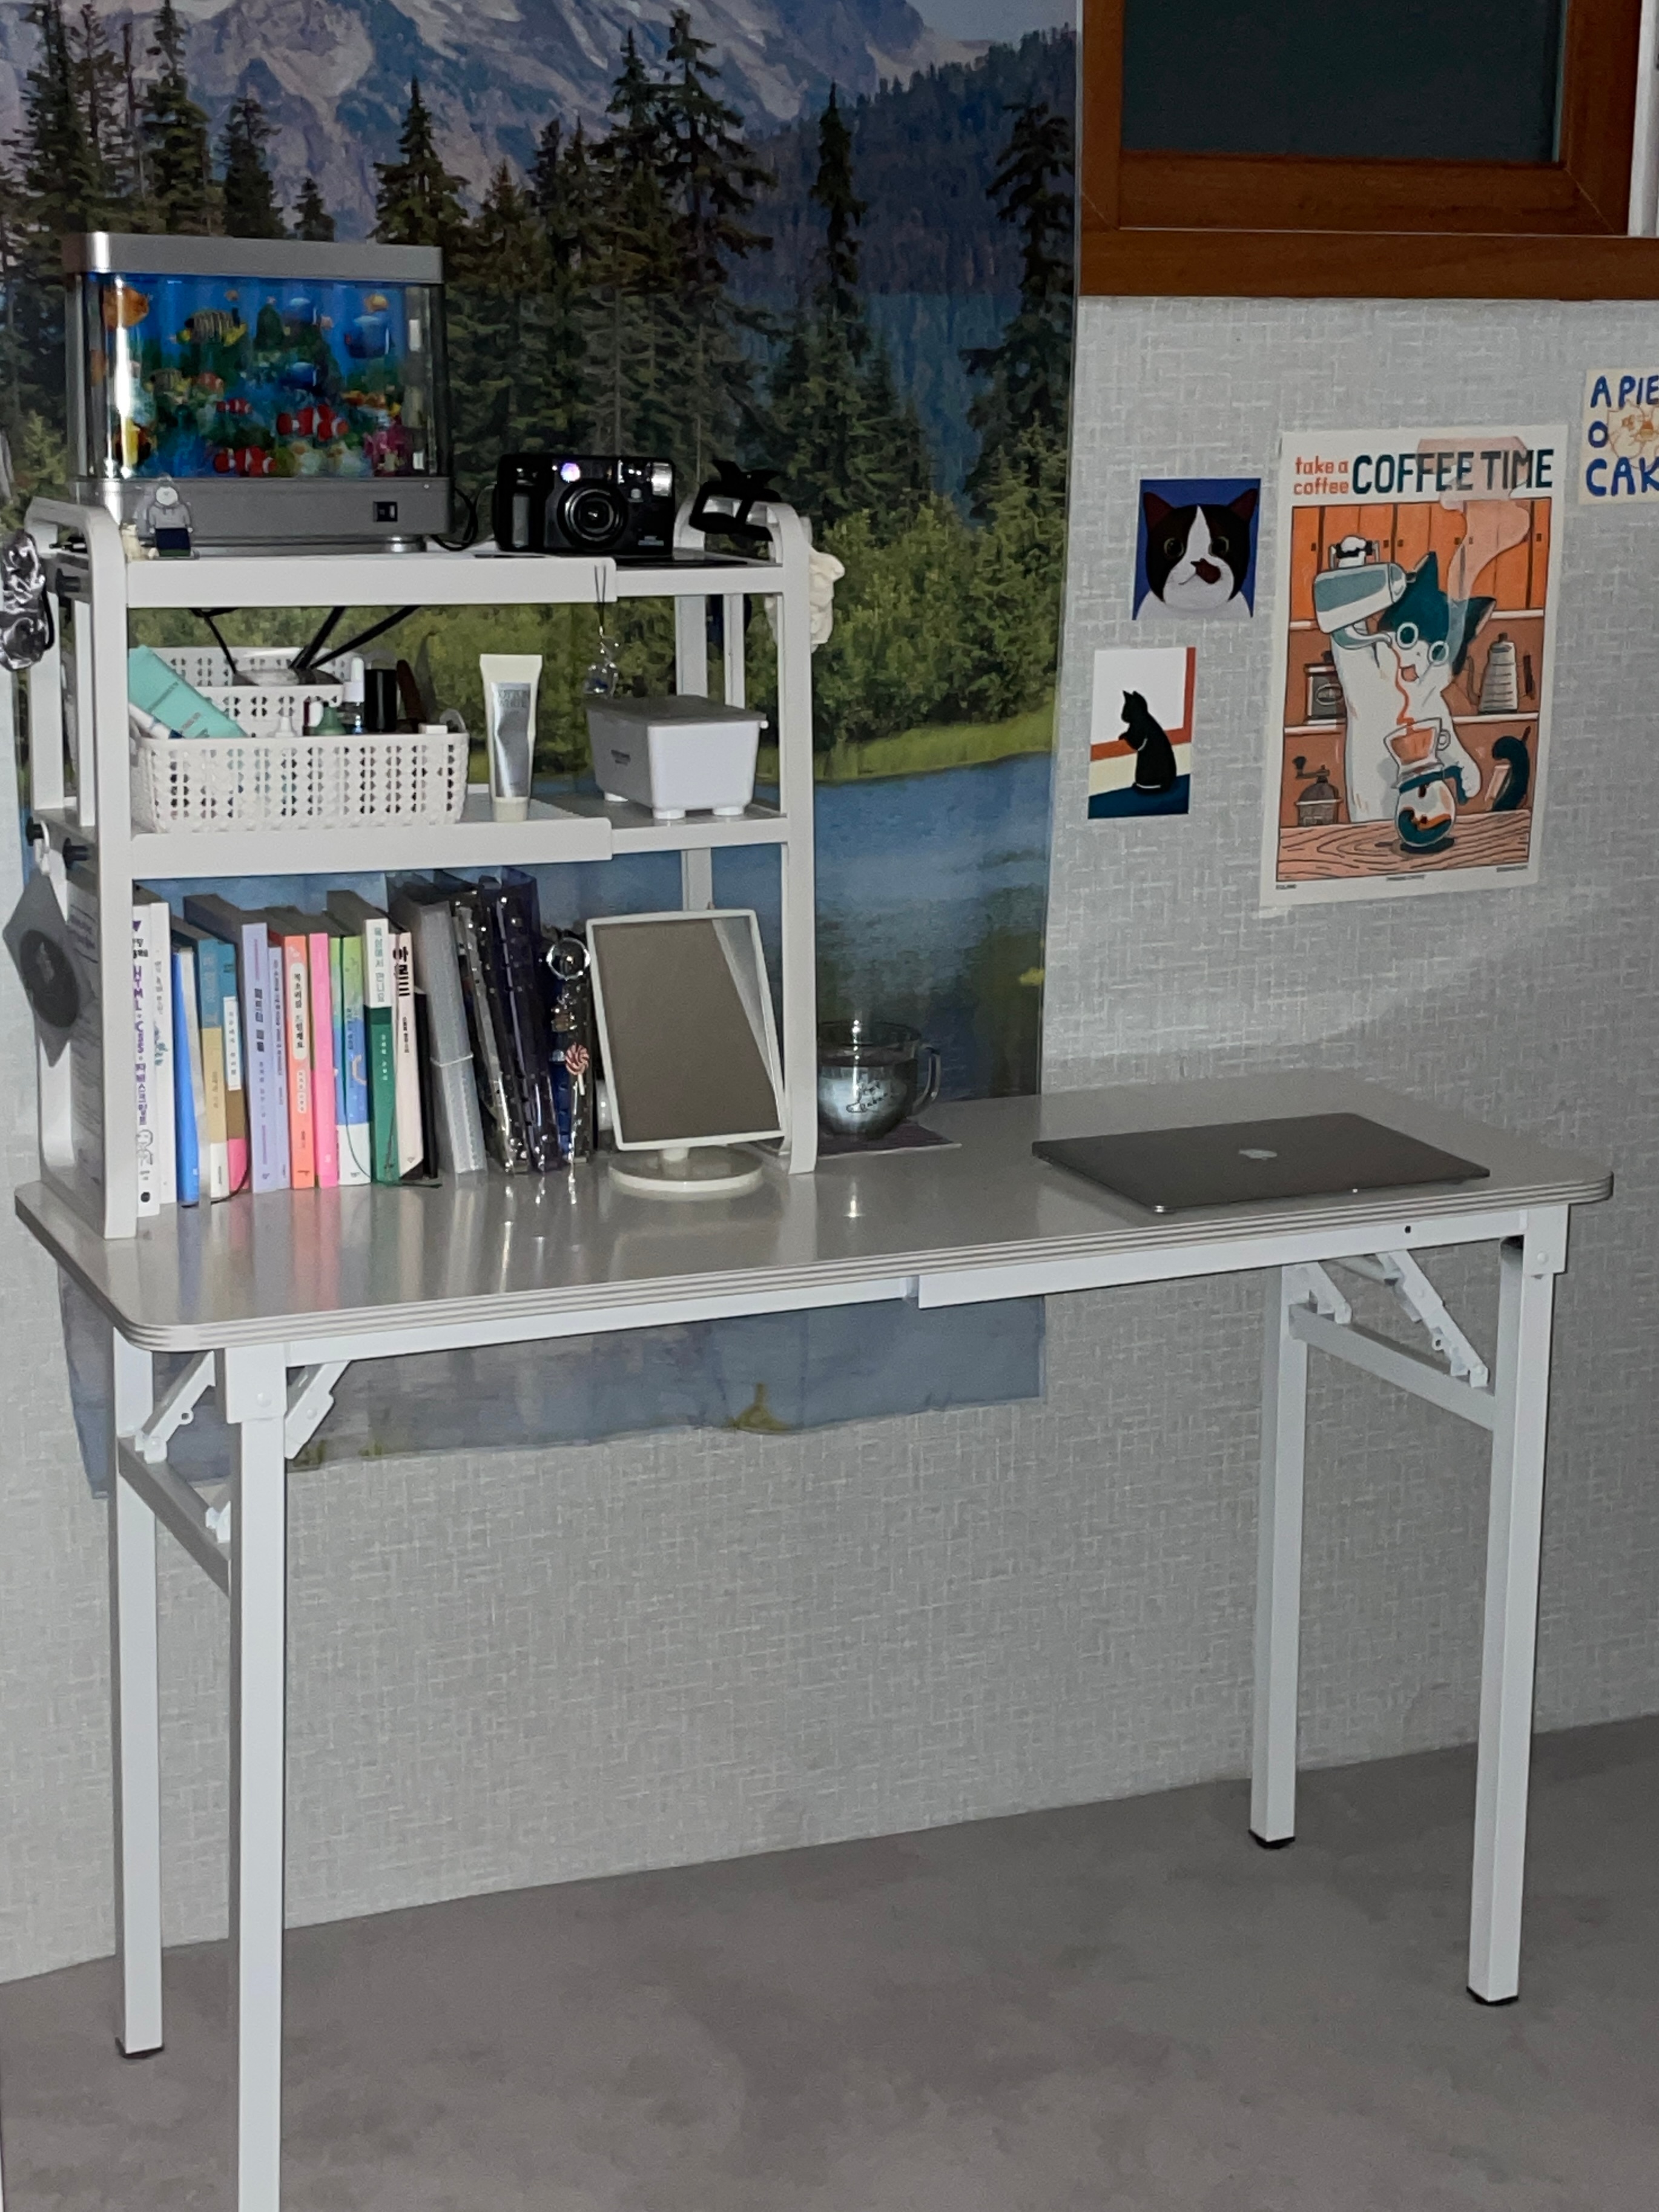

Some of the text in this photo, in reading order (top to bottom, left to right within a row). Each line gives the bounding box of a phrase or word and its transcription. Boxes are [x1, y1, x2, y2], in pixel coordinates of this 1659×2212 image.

[1590, 375, 1612, 408] A
[1295, 455, 1349, 475] take a
[1352, 449, 1554, 495] COFFEE TIME
[1293, 477, 1350, 495] coffee
[133, 965, 143, 1011] HTML
